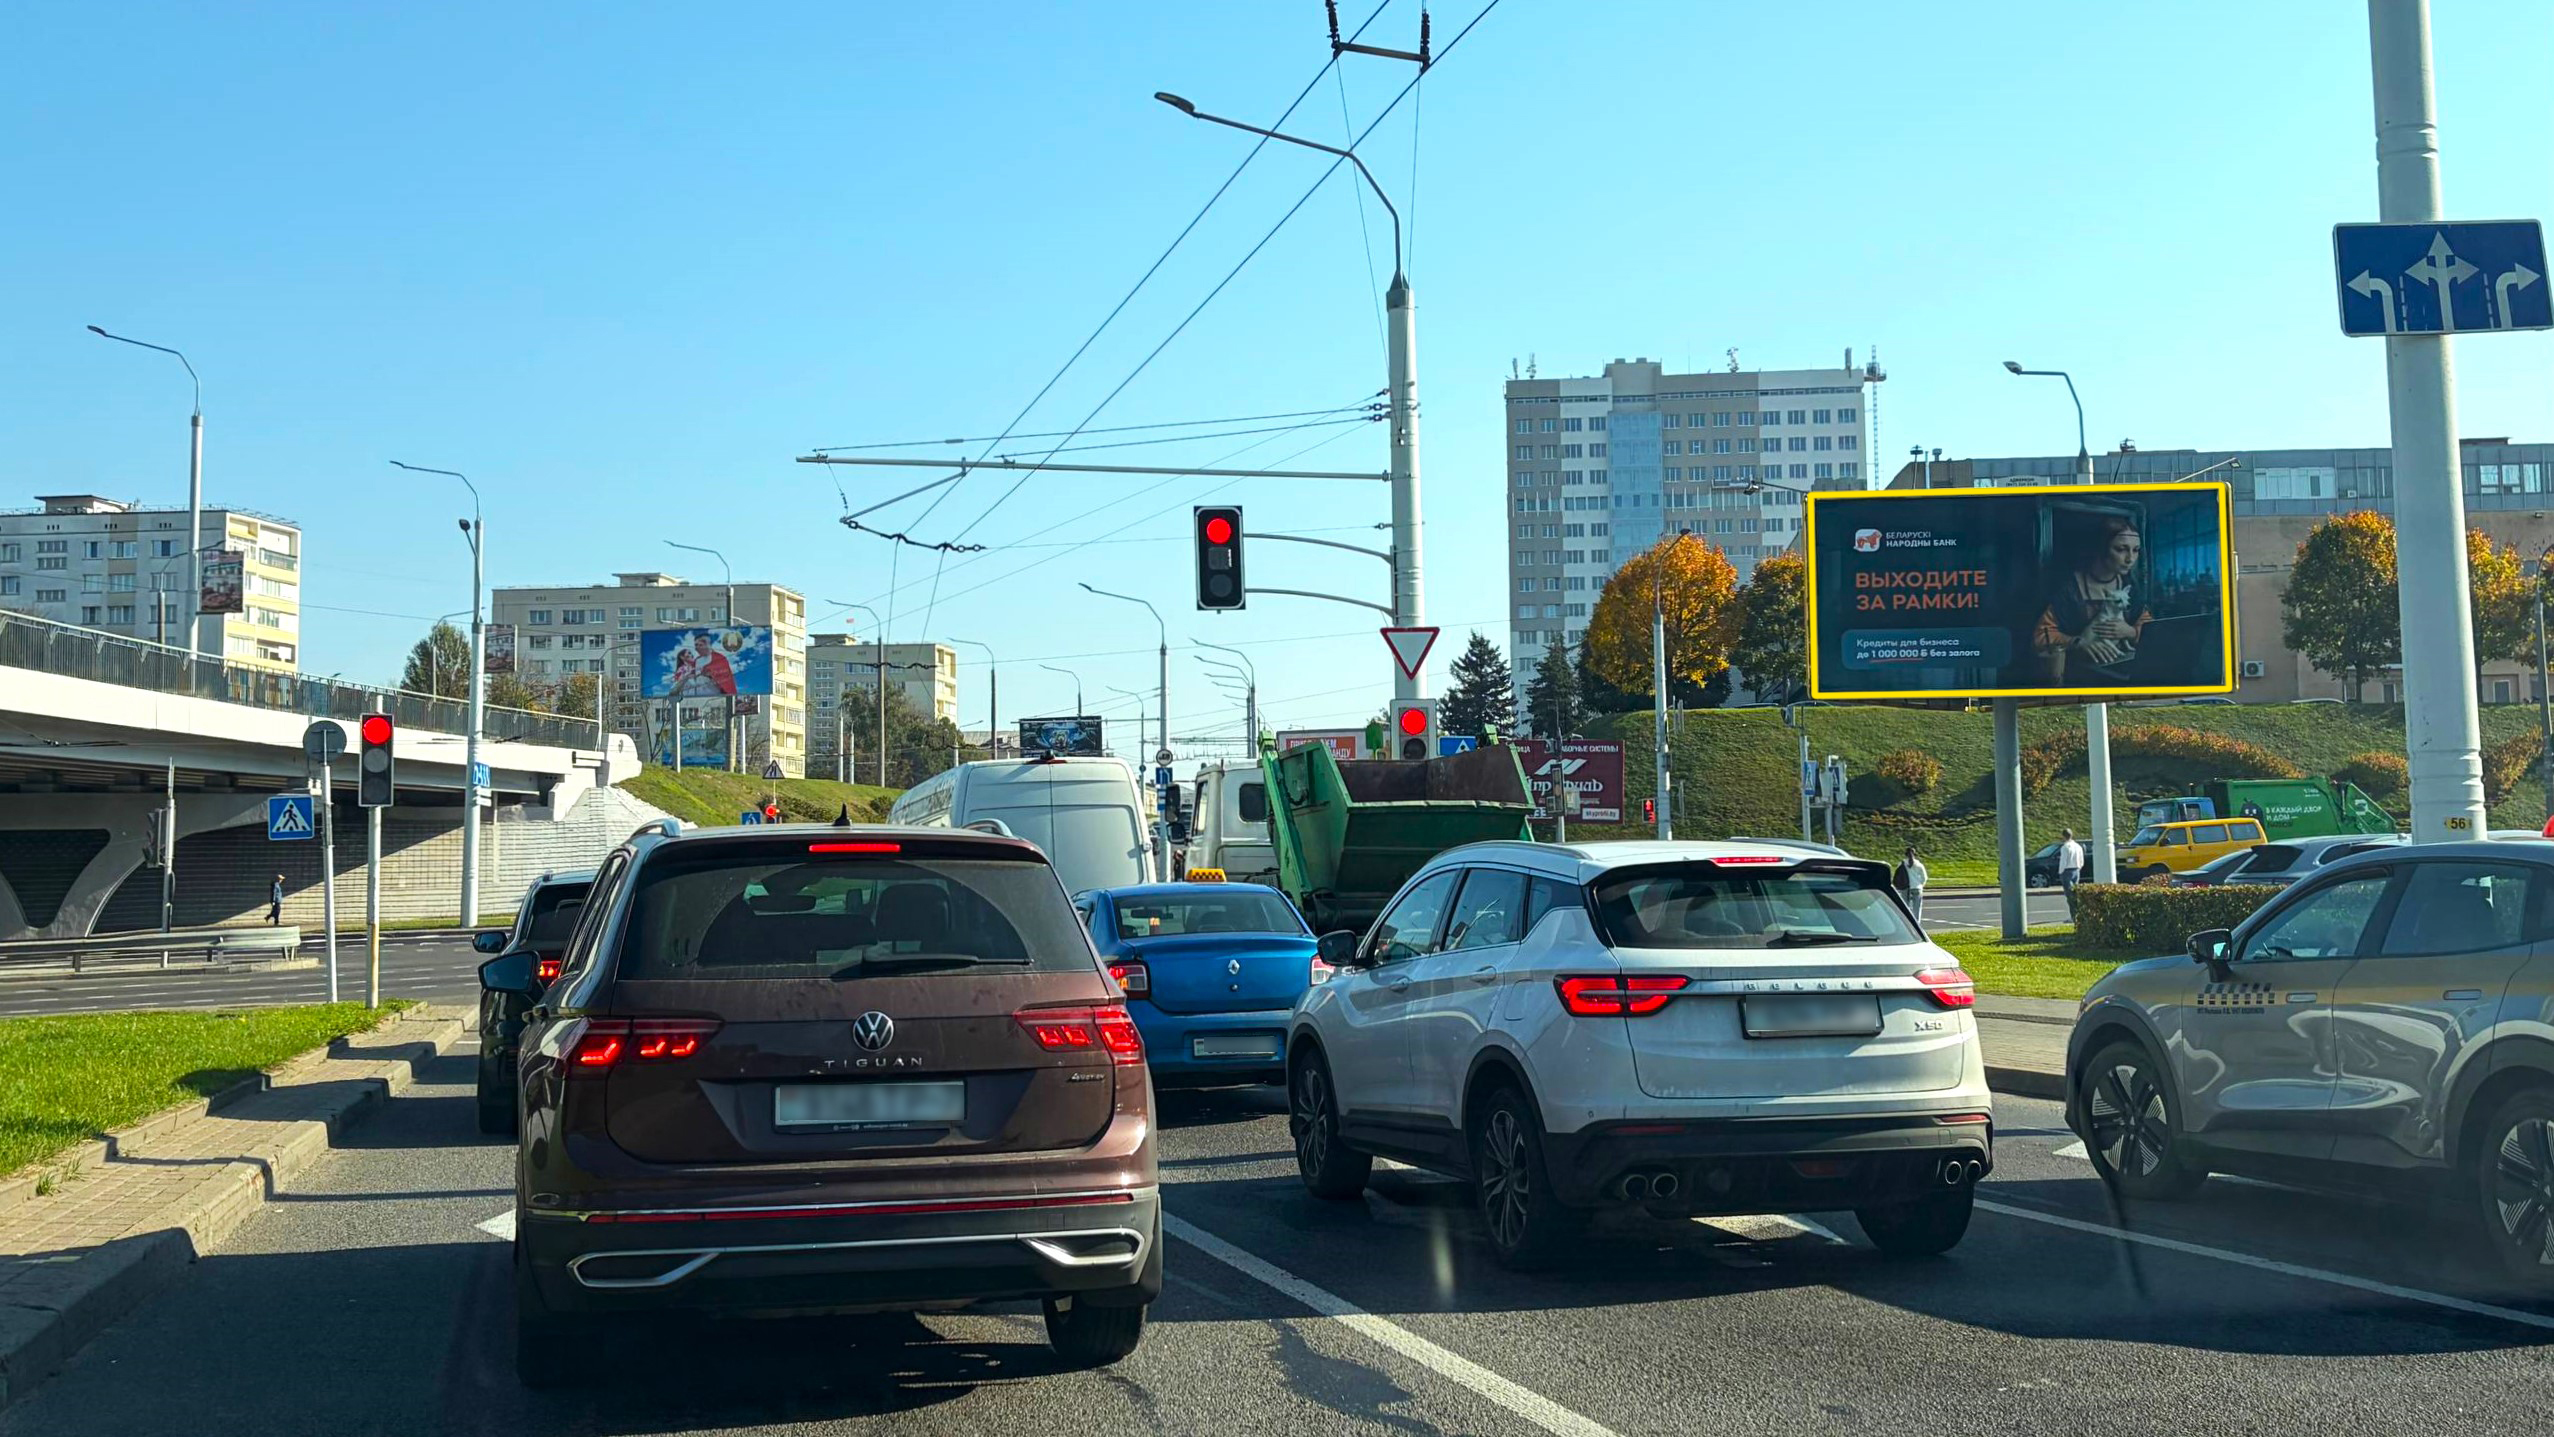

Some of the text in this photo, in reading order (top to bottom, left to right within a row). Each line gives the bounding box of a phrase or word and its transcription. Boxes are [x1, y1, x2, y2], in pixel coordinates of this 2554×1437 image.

[1886, 531, 1931, 540] БЕЛАРУСКІ
[1886, 539, 1957, 548] НАРОДНЫ БАНК
[1855, 570, 1987, 590] ВЫХОДИТЕ
[1856, 593, 1979, 610] ЗА РАМКИ!
[1857, 638, 1960, 649] Кредиты для бизнеса
[1856, 651, 1869, 660] до
[1930, 648, 1947, 657] без
[1948, 649, 1980, 658] залога
[1562, 745, 1619, 753] АБОРНЫЕ СИСТЕМЫ
[2271, 805, 2303, 814] КАЖДЫЙ
[2303, 805, 2322, 813] ДВОР
[2273, 813, 2290, 821] ДОМ
[2451, 817, 2466, 829] 56
[1914, 1019, 1944, 1032] X50
[823, 1057, 923, 1069] TIGUAN
